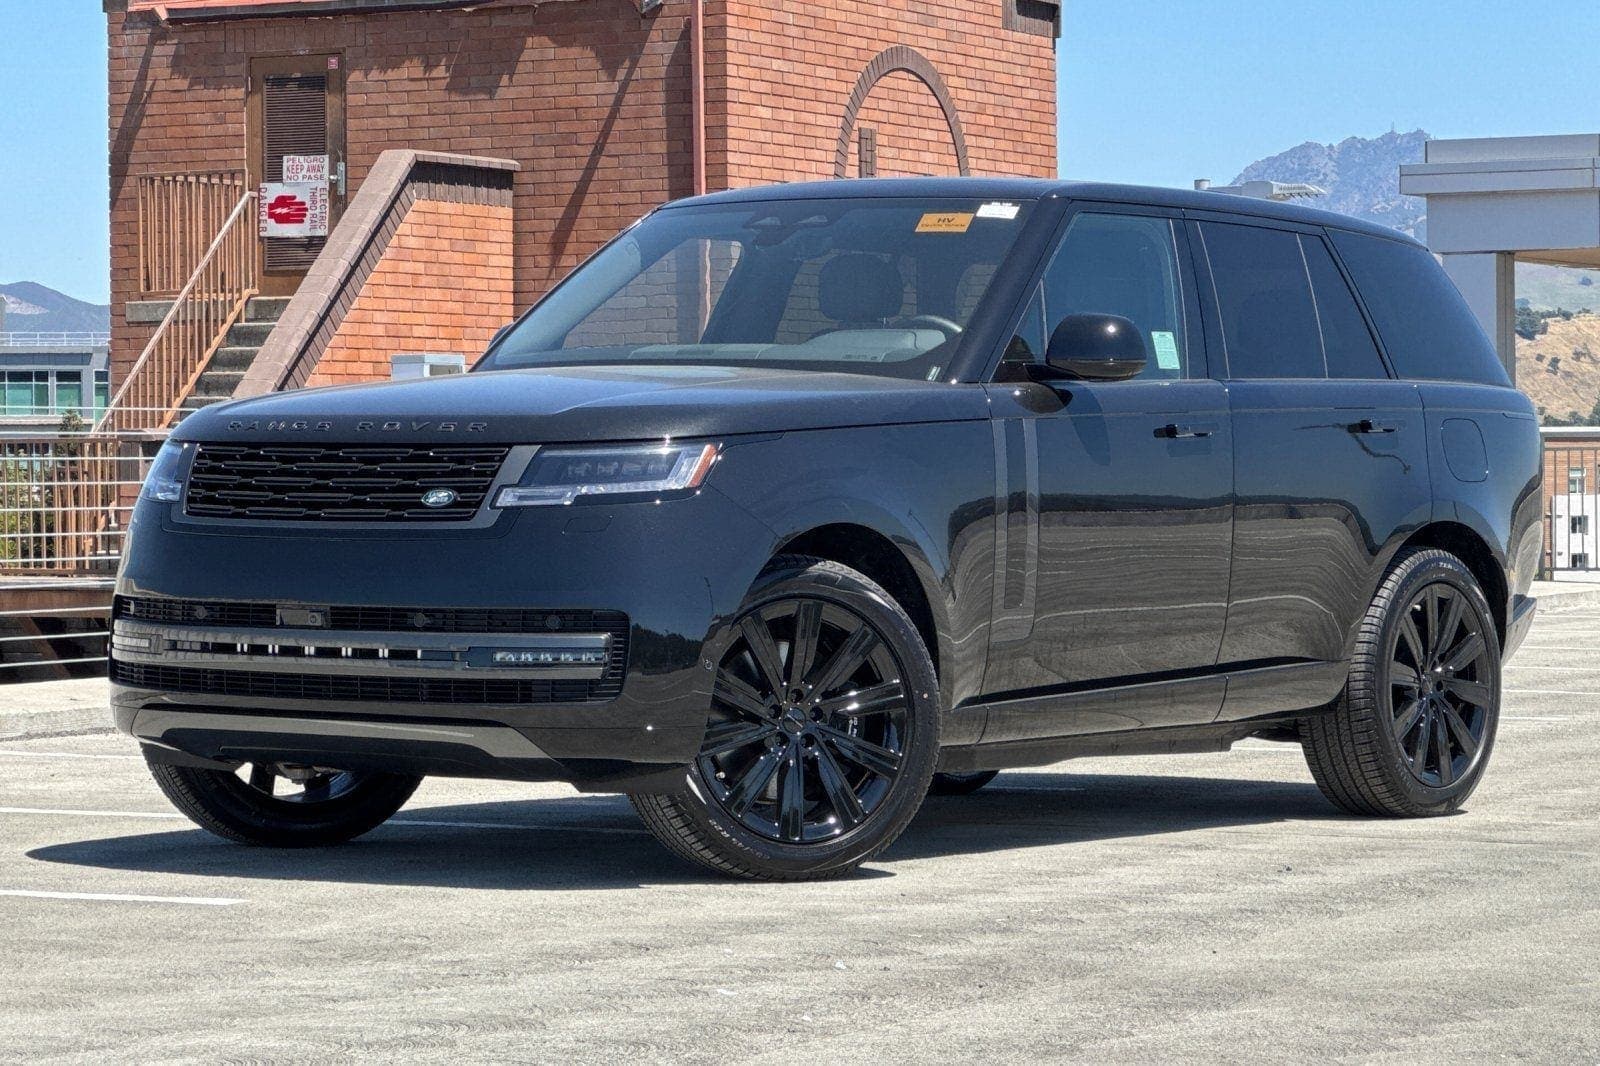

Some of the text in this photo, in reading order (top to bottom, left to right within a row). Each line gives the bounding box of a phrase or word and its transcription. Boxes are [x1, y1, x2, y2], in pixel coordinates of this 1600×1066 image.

[286, 164, 325, 174] KEEP AWAY
[259, 187, 267, 233] DANGER
[309, 187, 318, 232] THIRD RAIL
[319, 187, 327, 231] ELECTRIC
[356, 421, 489, 432] ROVER
